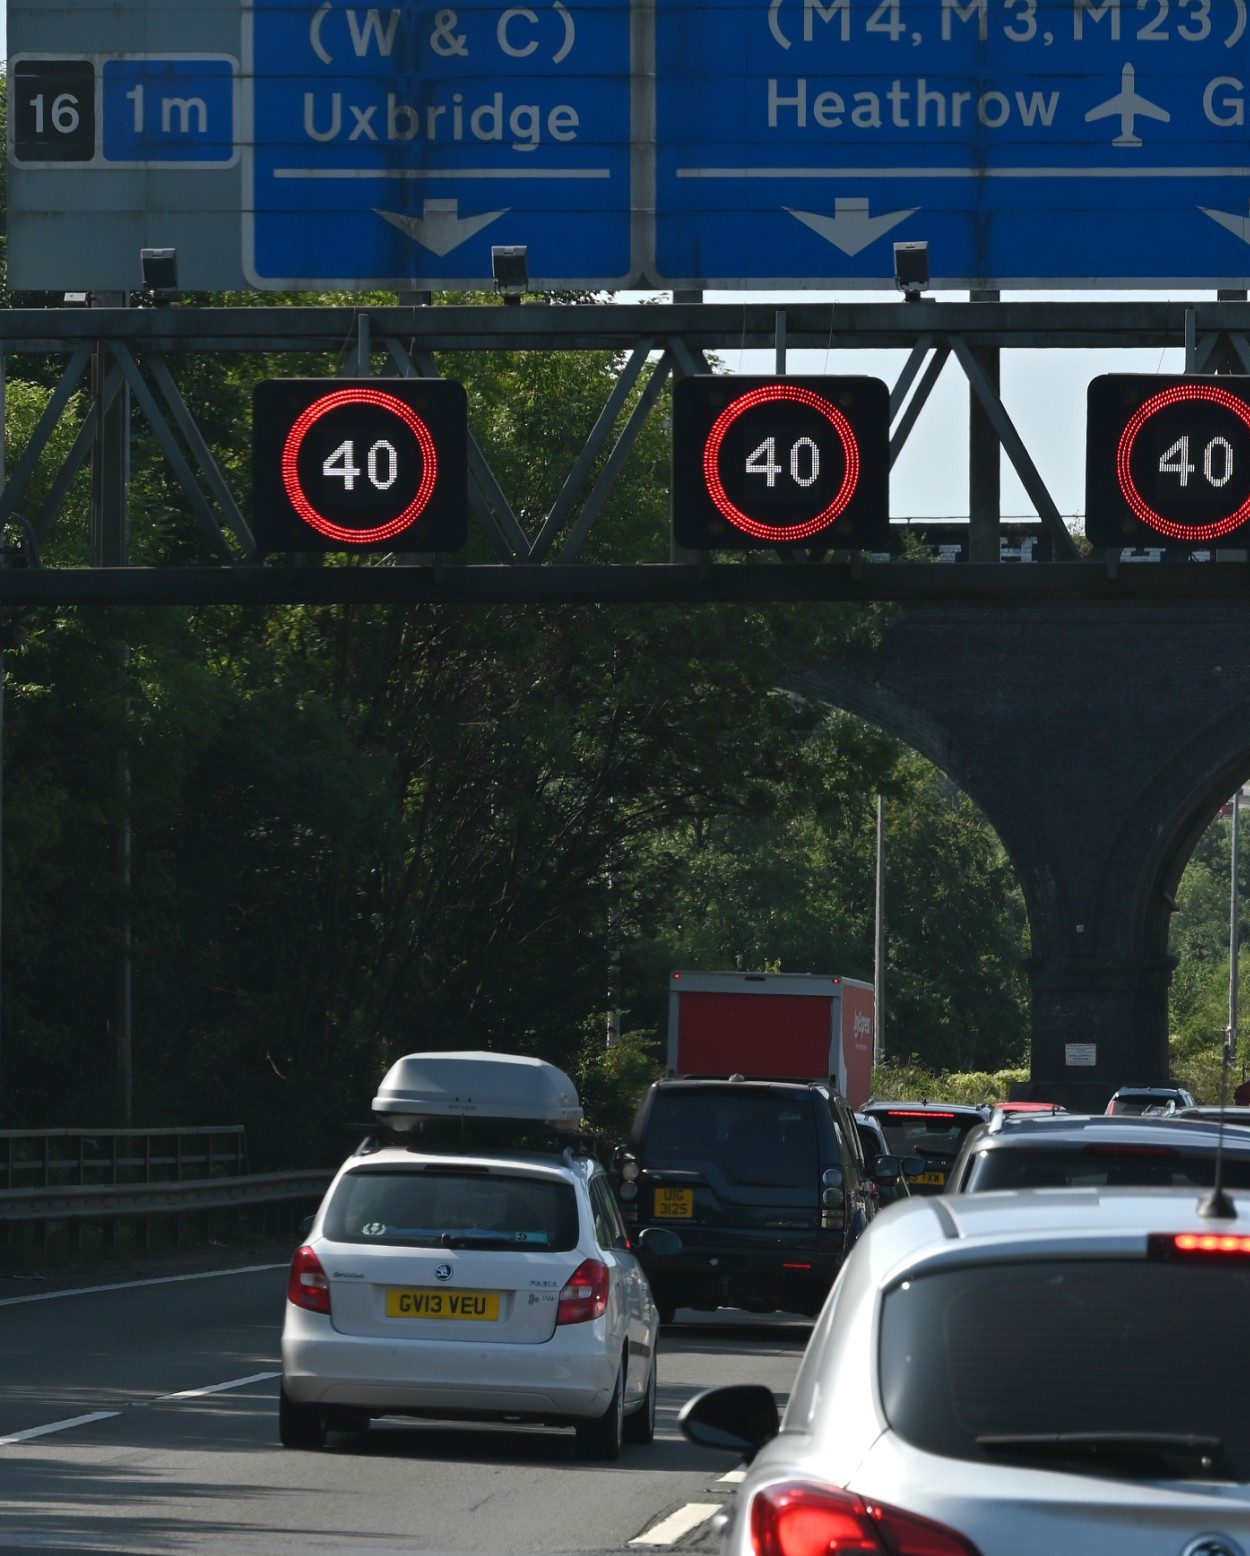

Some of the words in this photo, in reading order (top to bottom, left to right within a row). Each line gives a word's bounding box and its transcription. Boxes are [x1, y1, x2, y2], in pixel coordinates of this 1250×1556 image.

[310, 1, 397, 64] (W
[429, 11, 469, 57] &
[496, 1, 576, 64] C)
[29, 93, 80, 134] 16
[303, 91, 580, 152] Uxbridge
[767, 79, 1061, 128] Heathrow
[322, 439, 398, 490] 40
[745, 436, 821, 487] 40
[1158, 435, 1235, 487] 40
[400, 1294, 442, 1313] GV13
[449, 1295, 486, 1315] VEU
